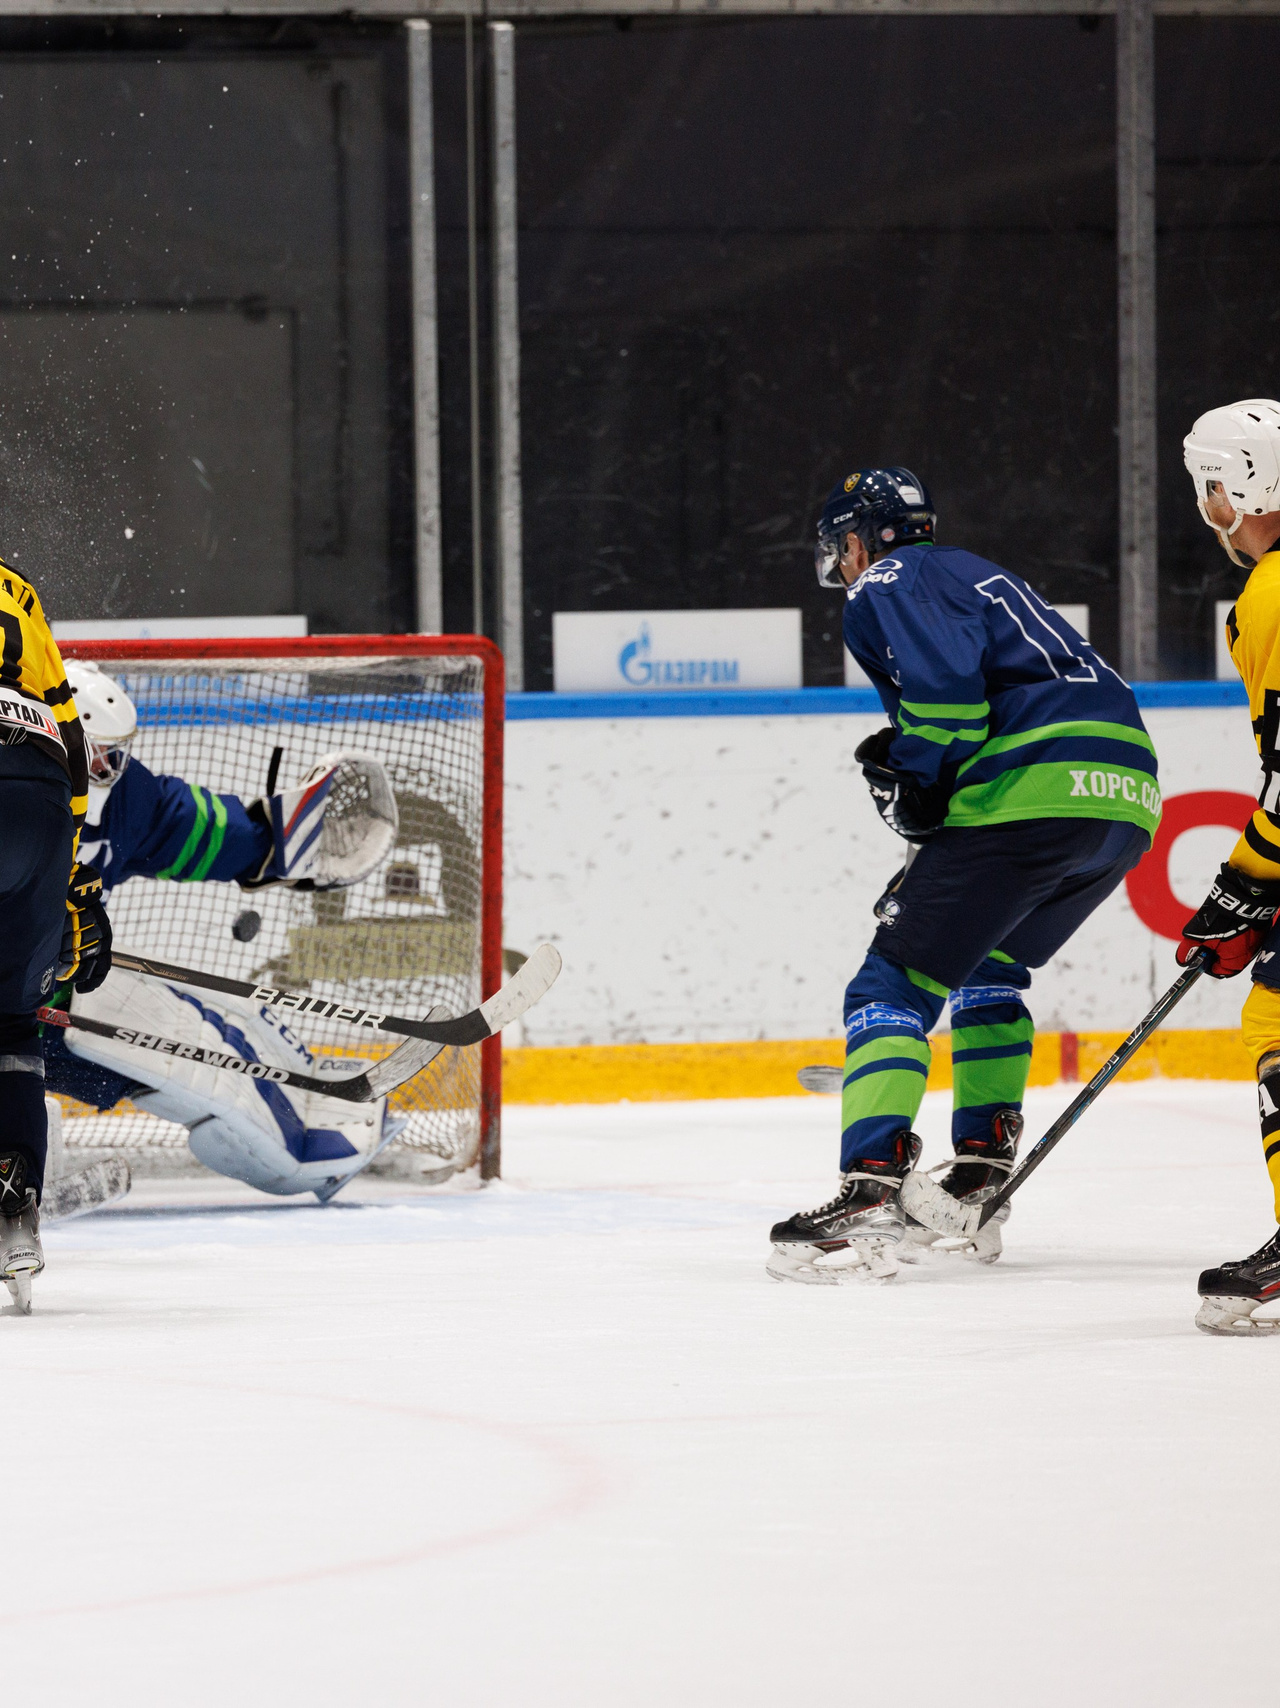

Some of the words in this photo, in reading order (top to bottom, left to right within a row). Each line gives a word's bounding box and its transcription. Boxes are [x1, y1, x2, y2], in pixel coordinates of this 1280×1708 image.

[833, 511, 854, 525] CCM
[260, 1005, 315, 1066] CCM
[821, 1203, 897, 1235] VAPOR
